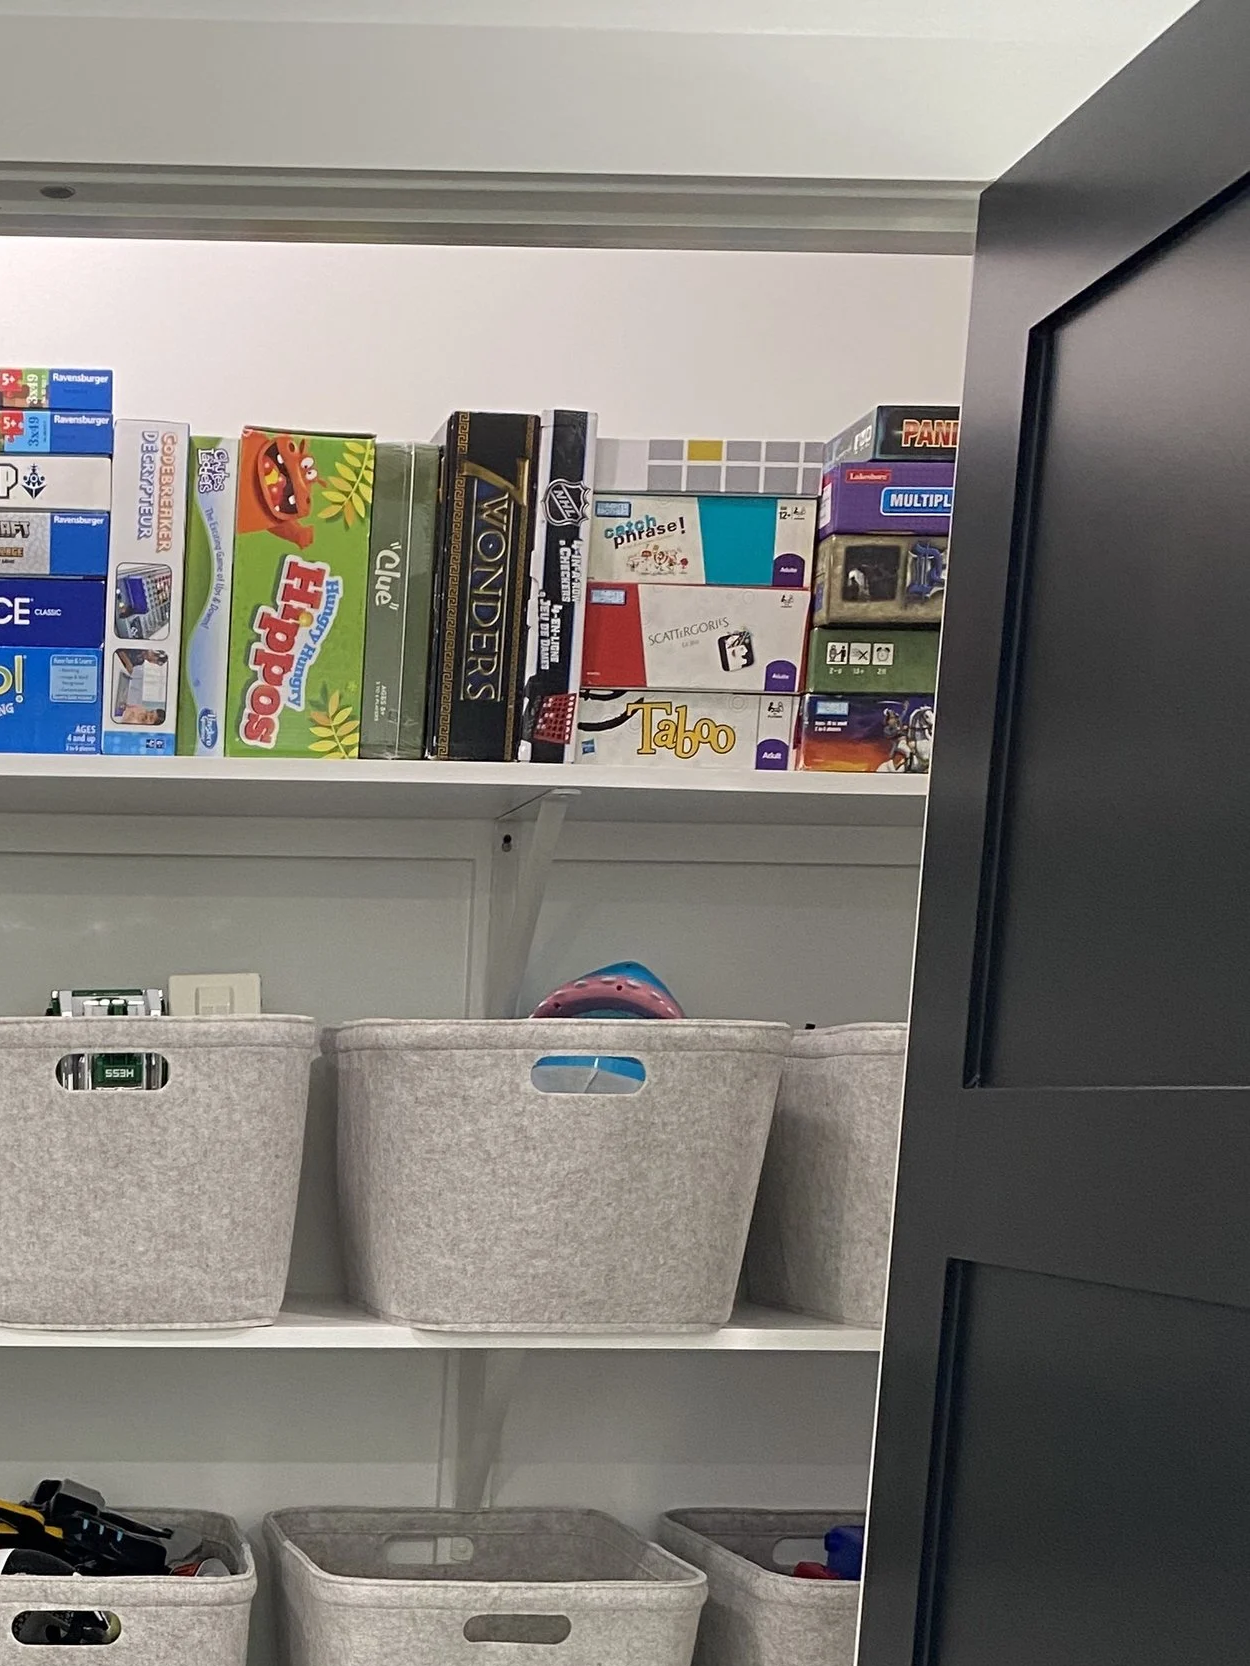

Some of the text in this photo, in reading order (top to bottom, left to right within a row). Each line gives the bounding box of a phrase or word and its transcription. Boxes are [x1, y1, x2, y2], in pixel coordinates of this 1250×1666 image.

[1, 372, 16, 386] 5+
[26, 373, 39, 404] 3x49
[52, 373, 109, 385] Ravensburger
[2, 416, 17, 430] 5+
[28, 416, 40, 447] 3x49
[53, 415, 110, 426] Ravensburger
[137, 430, 159, 540] DÉCRYPTEUR
[197, 448, 214, 494] Ladders
[212, 448, 230, 492] Chutes
[461, 457, 530, 507] 7
[156, 431, 178, 554] CODEBREAKER
[553, 487, 574, 519] NHL
[53, 515, 104, 526] Ravensburger
[204, 507, 214, 521] The
[603, 514, 657, 539] catch
[613, 516, 686, 550] phrase!
[215, 551, 225, 572] Game
[559, 546, 572, 603] CHECKERS
[213, 582, 224, 596] Ups
[216, 573, 225, 582] of
[466, 492, 510, 702] WONDERS
[34, 608, 62, 617] CLASSIC
[286, 578, 341, 707] Hungry Hungry
[539, 598, 551, 670] JEU DE DAMES
[648, 616, 730, 646] SCATTERGORIES
[245, 558, 327, 746] Hippos
[66, 733, 96, 744] 4 and up
[74, 725, 97, 734] AGES
[627, 701, 736, 759] Taboo
[762, 751, 782, 761] Adult
[105, 1068, 135, 1078] HESS
